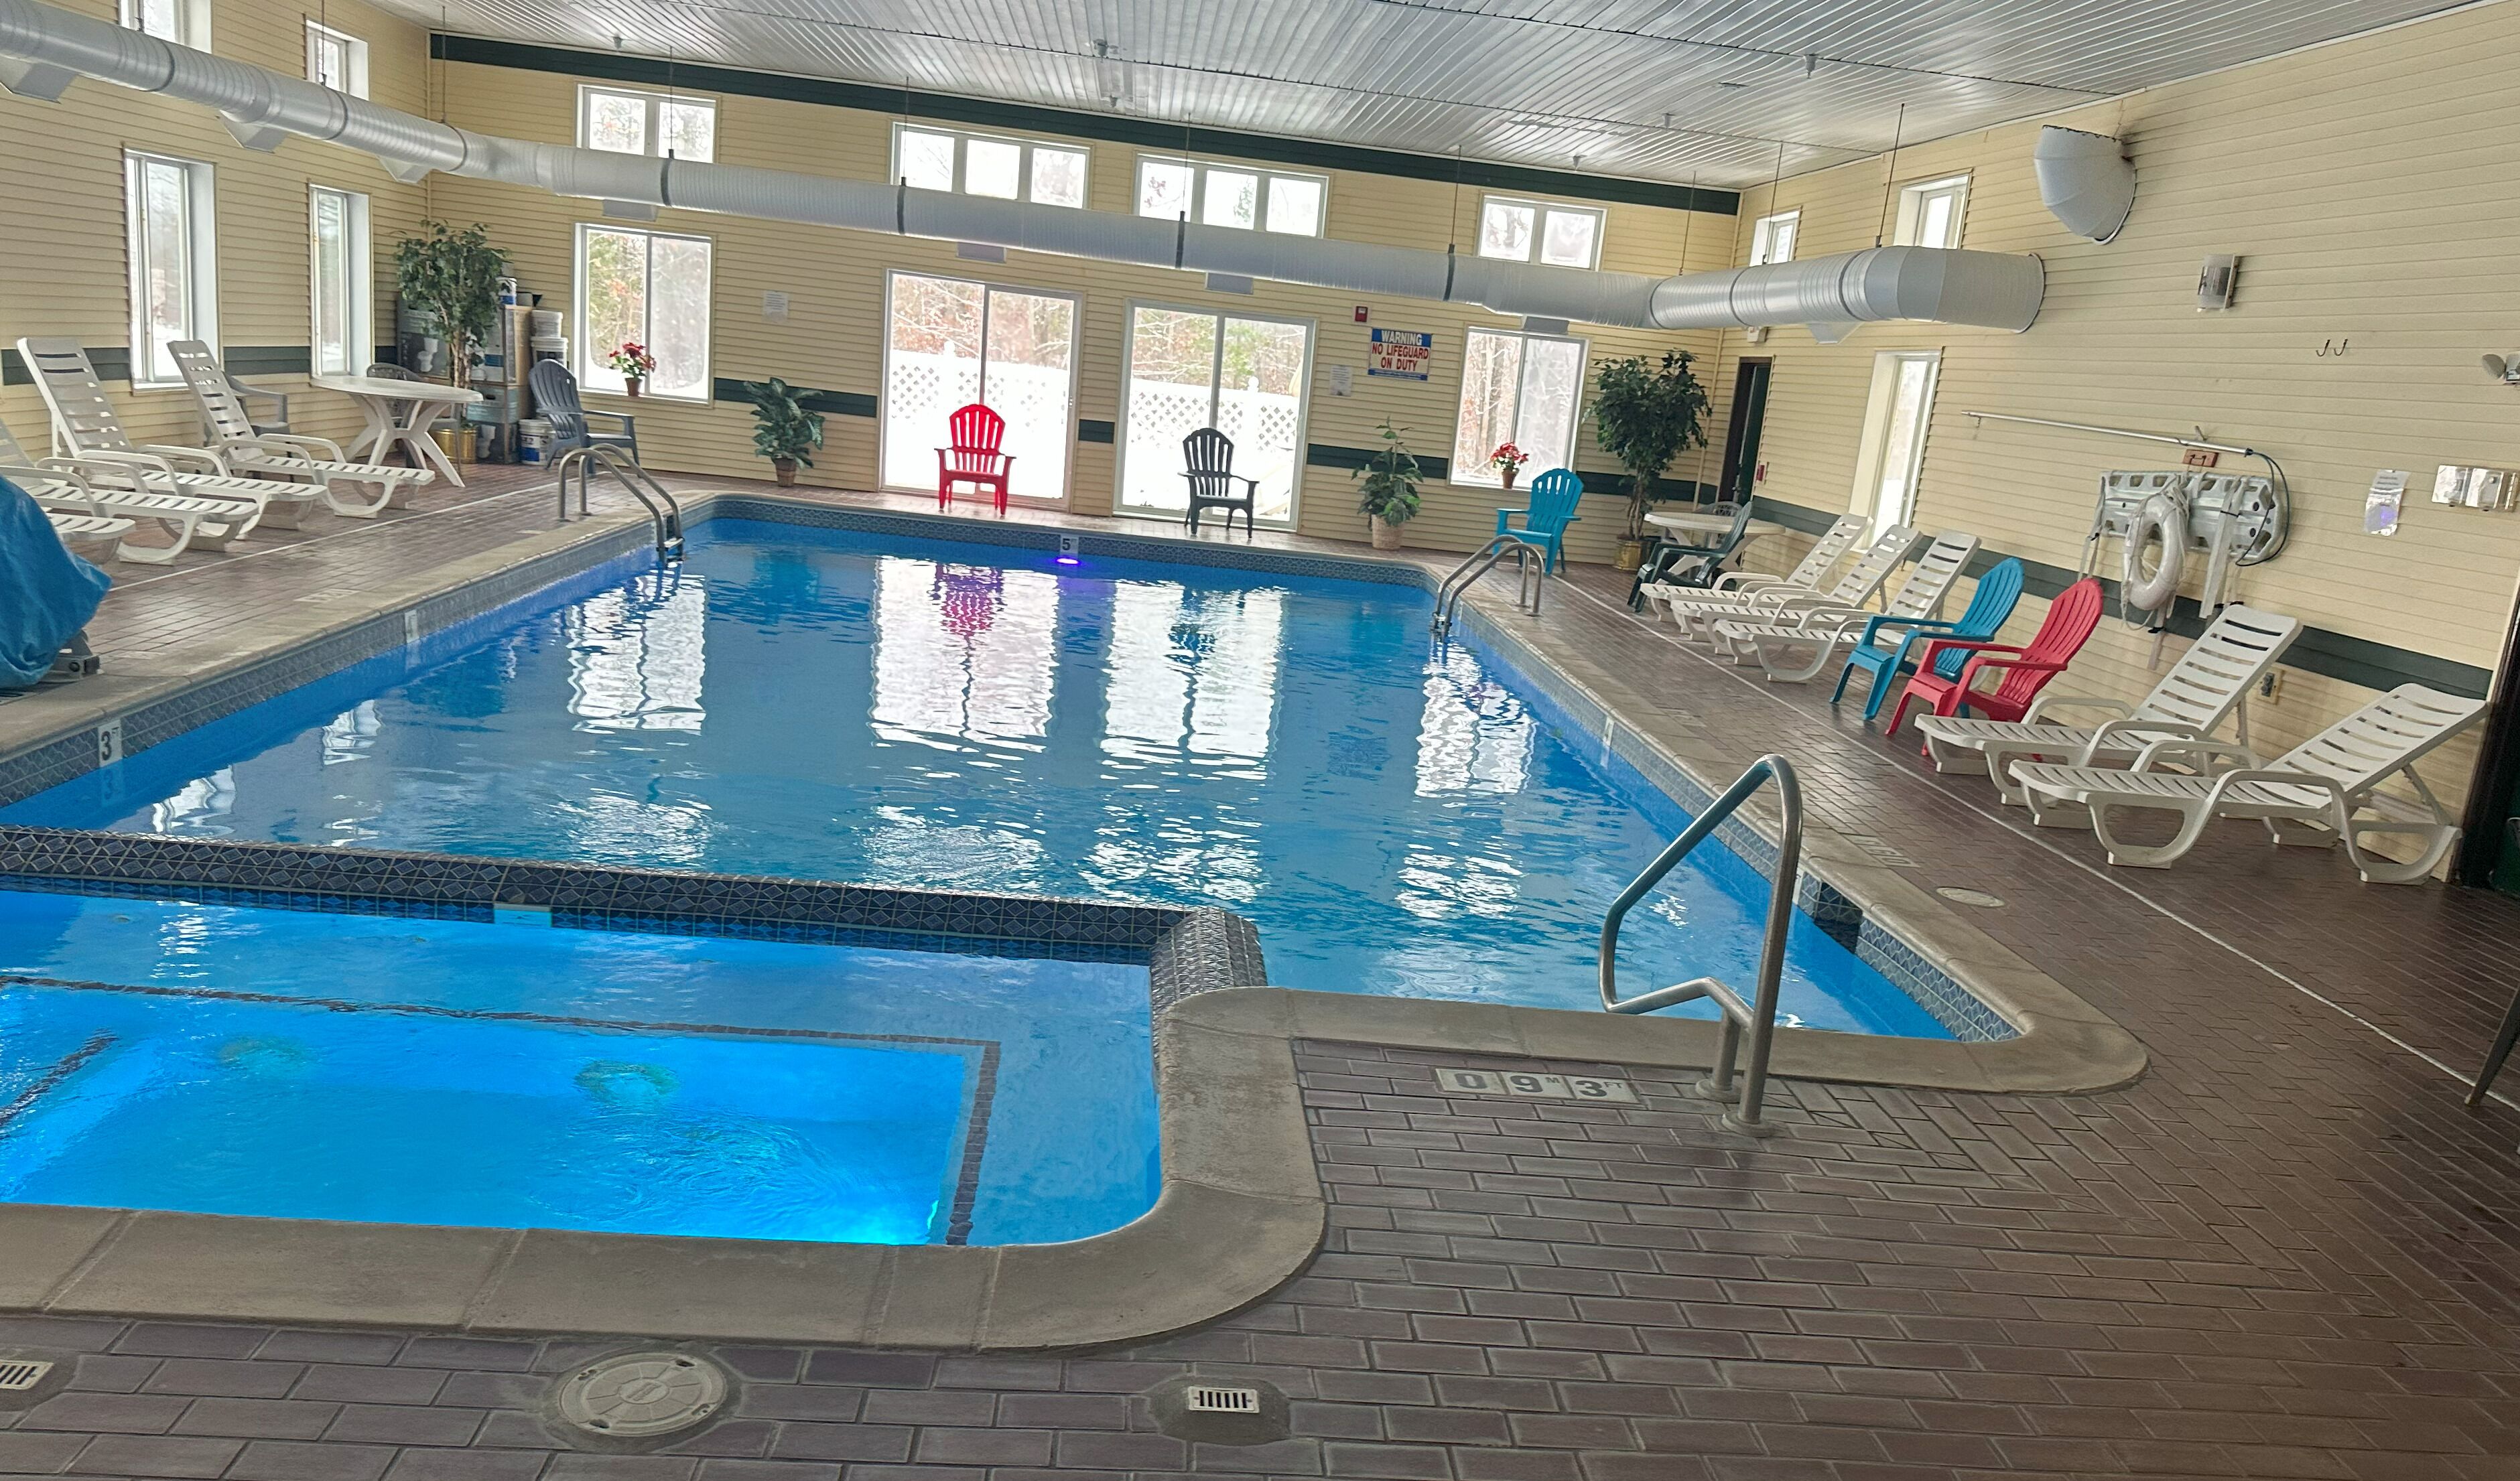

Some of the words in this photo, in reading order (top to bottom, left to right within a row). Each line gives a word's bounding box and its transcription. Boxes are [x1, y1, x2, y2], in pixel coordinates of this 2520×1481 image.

[1382, 330, 1422, 346] WARNING
[1372, 343, 1383, 354] NO
[1386, 344, 1429, 360] LIFEGUARD
[1381, 357, 1392, 368] ON
[1396, 358, 1418, 371] DUTY
[1063, 538, 1071, 551] 5
[101, 731, 112, 760] 3
